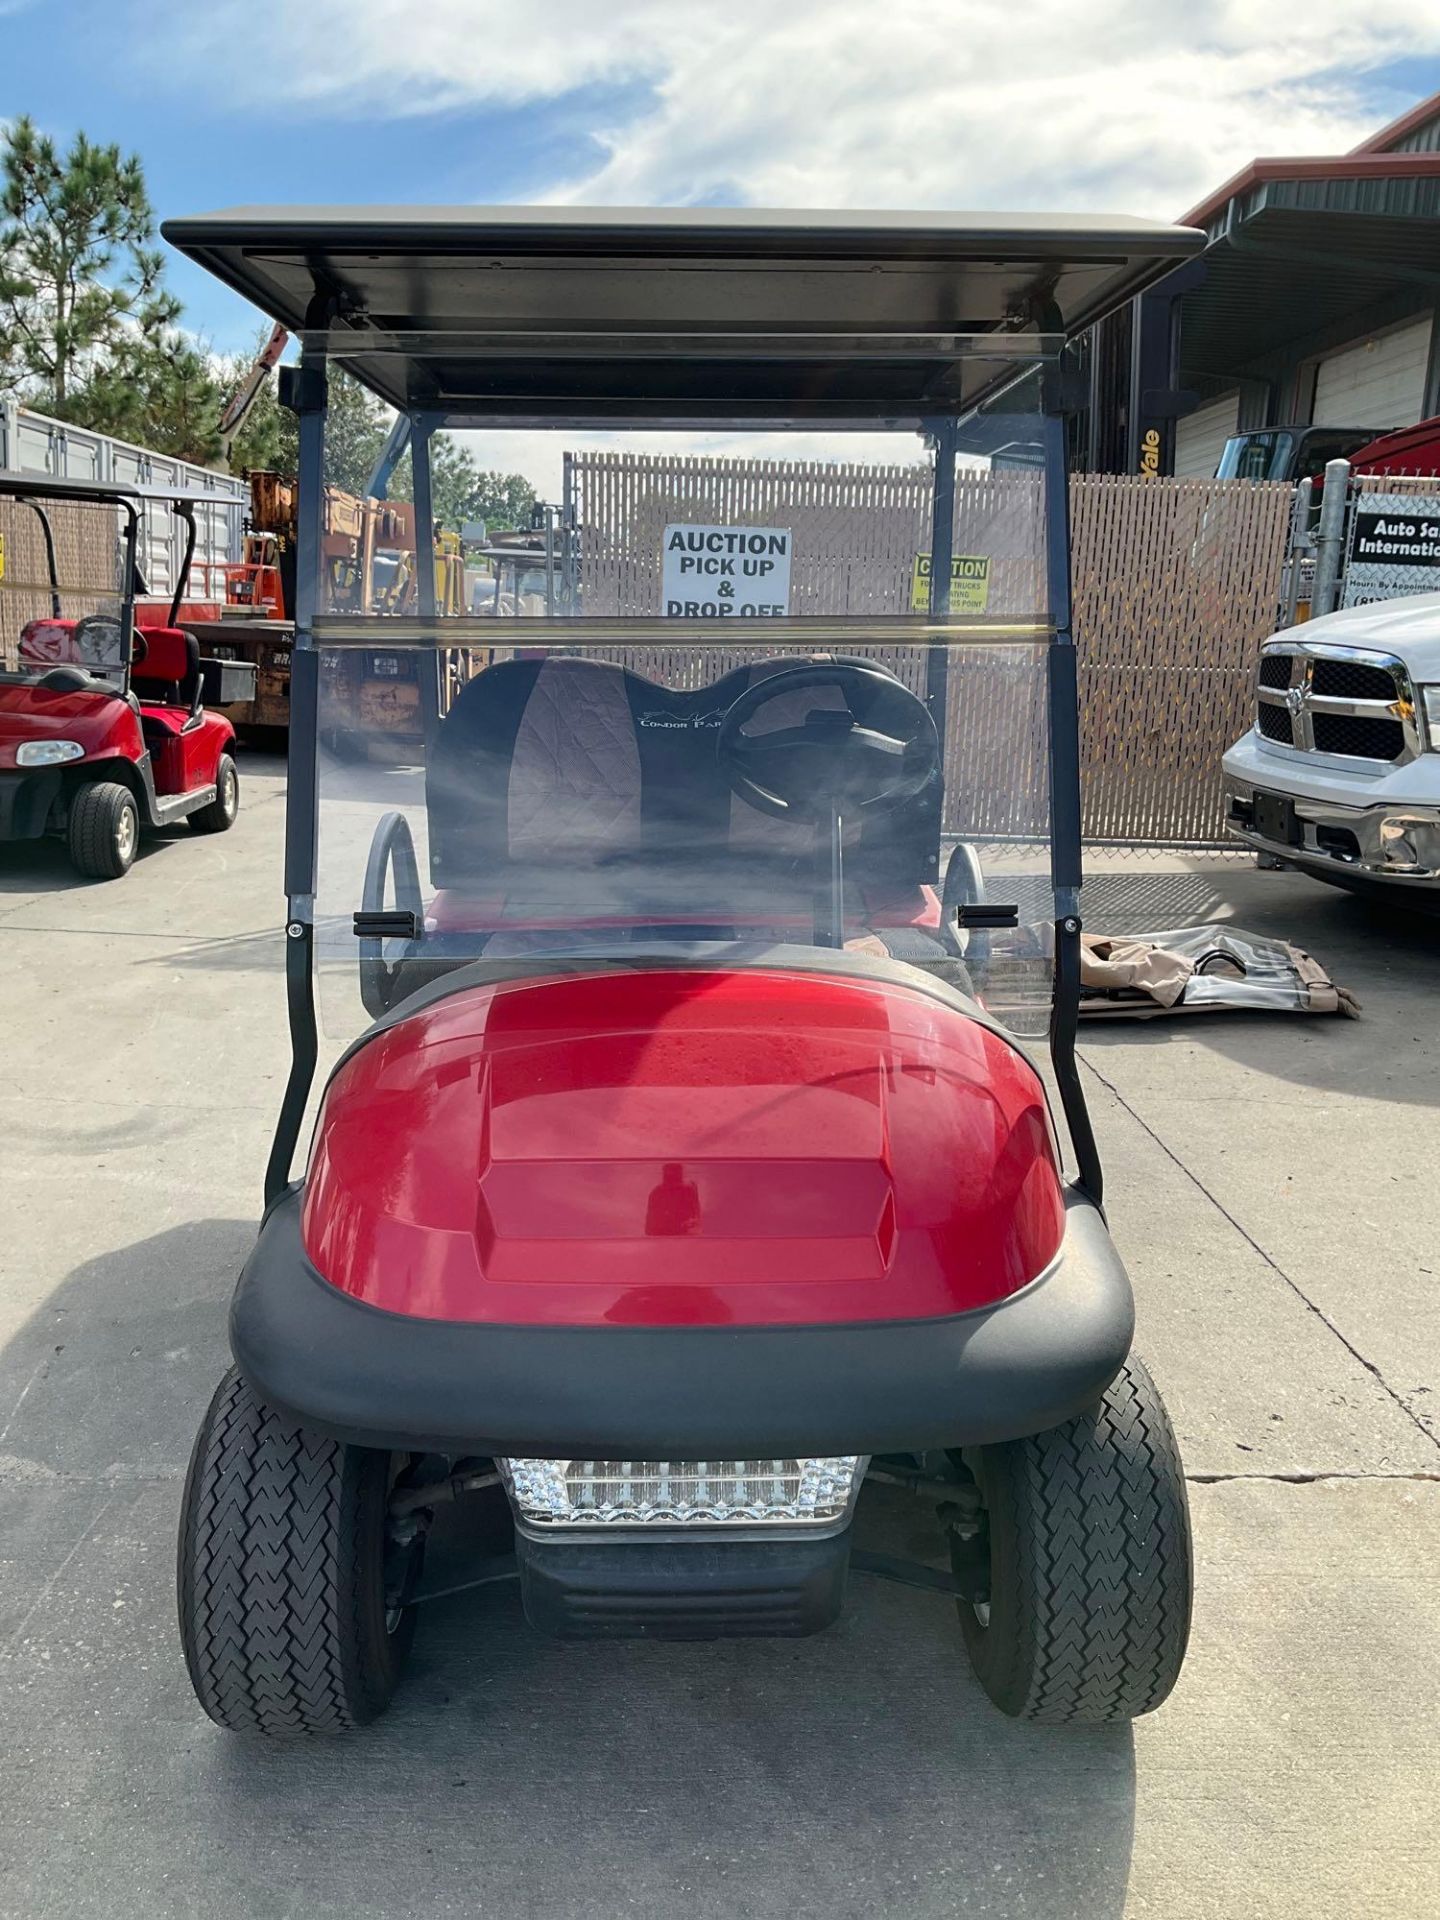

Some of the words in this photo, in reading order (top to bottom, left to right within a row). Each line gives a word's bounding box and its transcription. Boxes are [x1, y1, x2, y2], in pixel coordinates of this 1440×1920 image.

[1141, 430, 1160, 480] Yale
[1374, 520, 1415, 537] Auto
[1419, 522, 1440, 538] Sa
[668, 531, 787, 556] AUCTION
[680, 556, 736, 576] PICK
[743, 559, 775, 577] UP
[919, 559, 986, 577] CTION
[717, 580, 736, 598] &
[1378, 580, 1390, 590] By
[1391, 581, 1440, 591] Appointme
[667, 600, 734, 617] DROP
[740, 603, 785, 617] OFF
